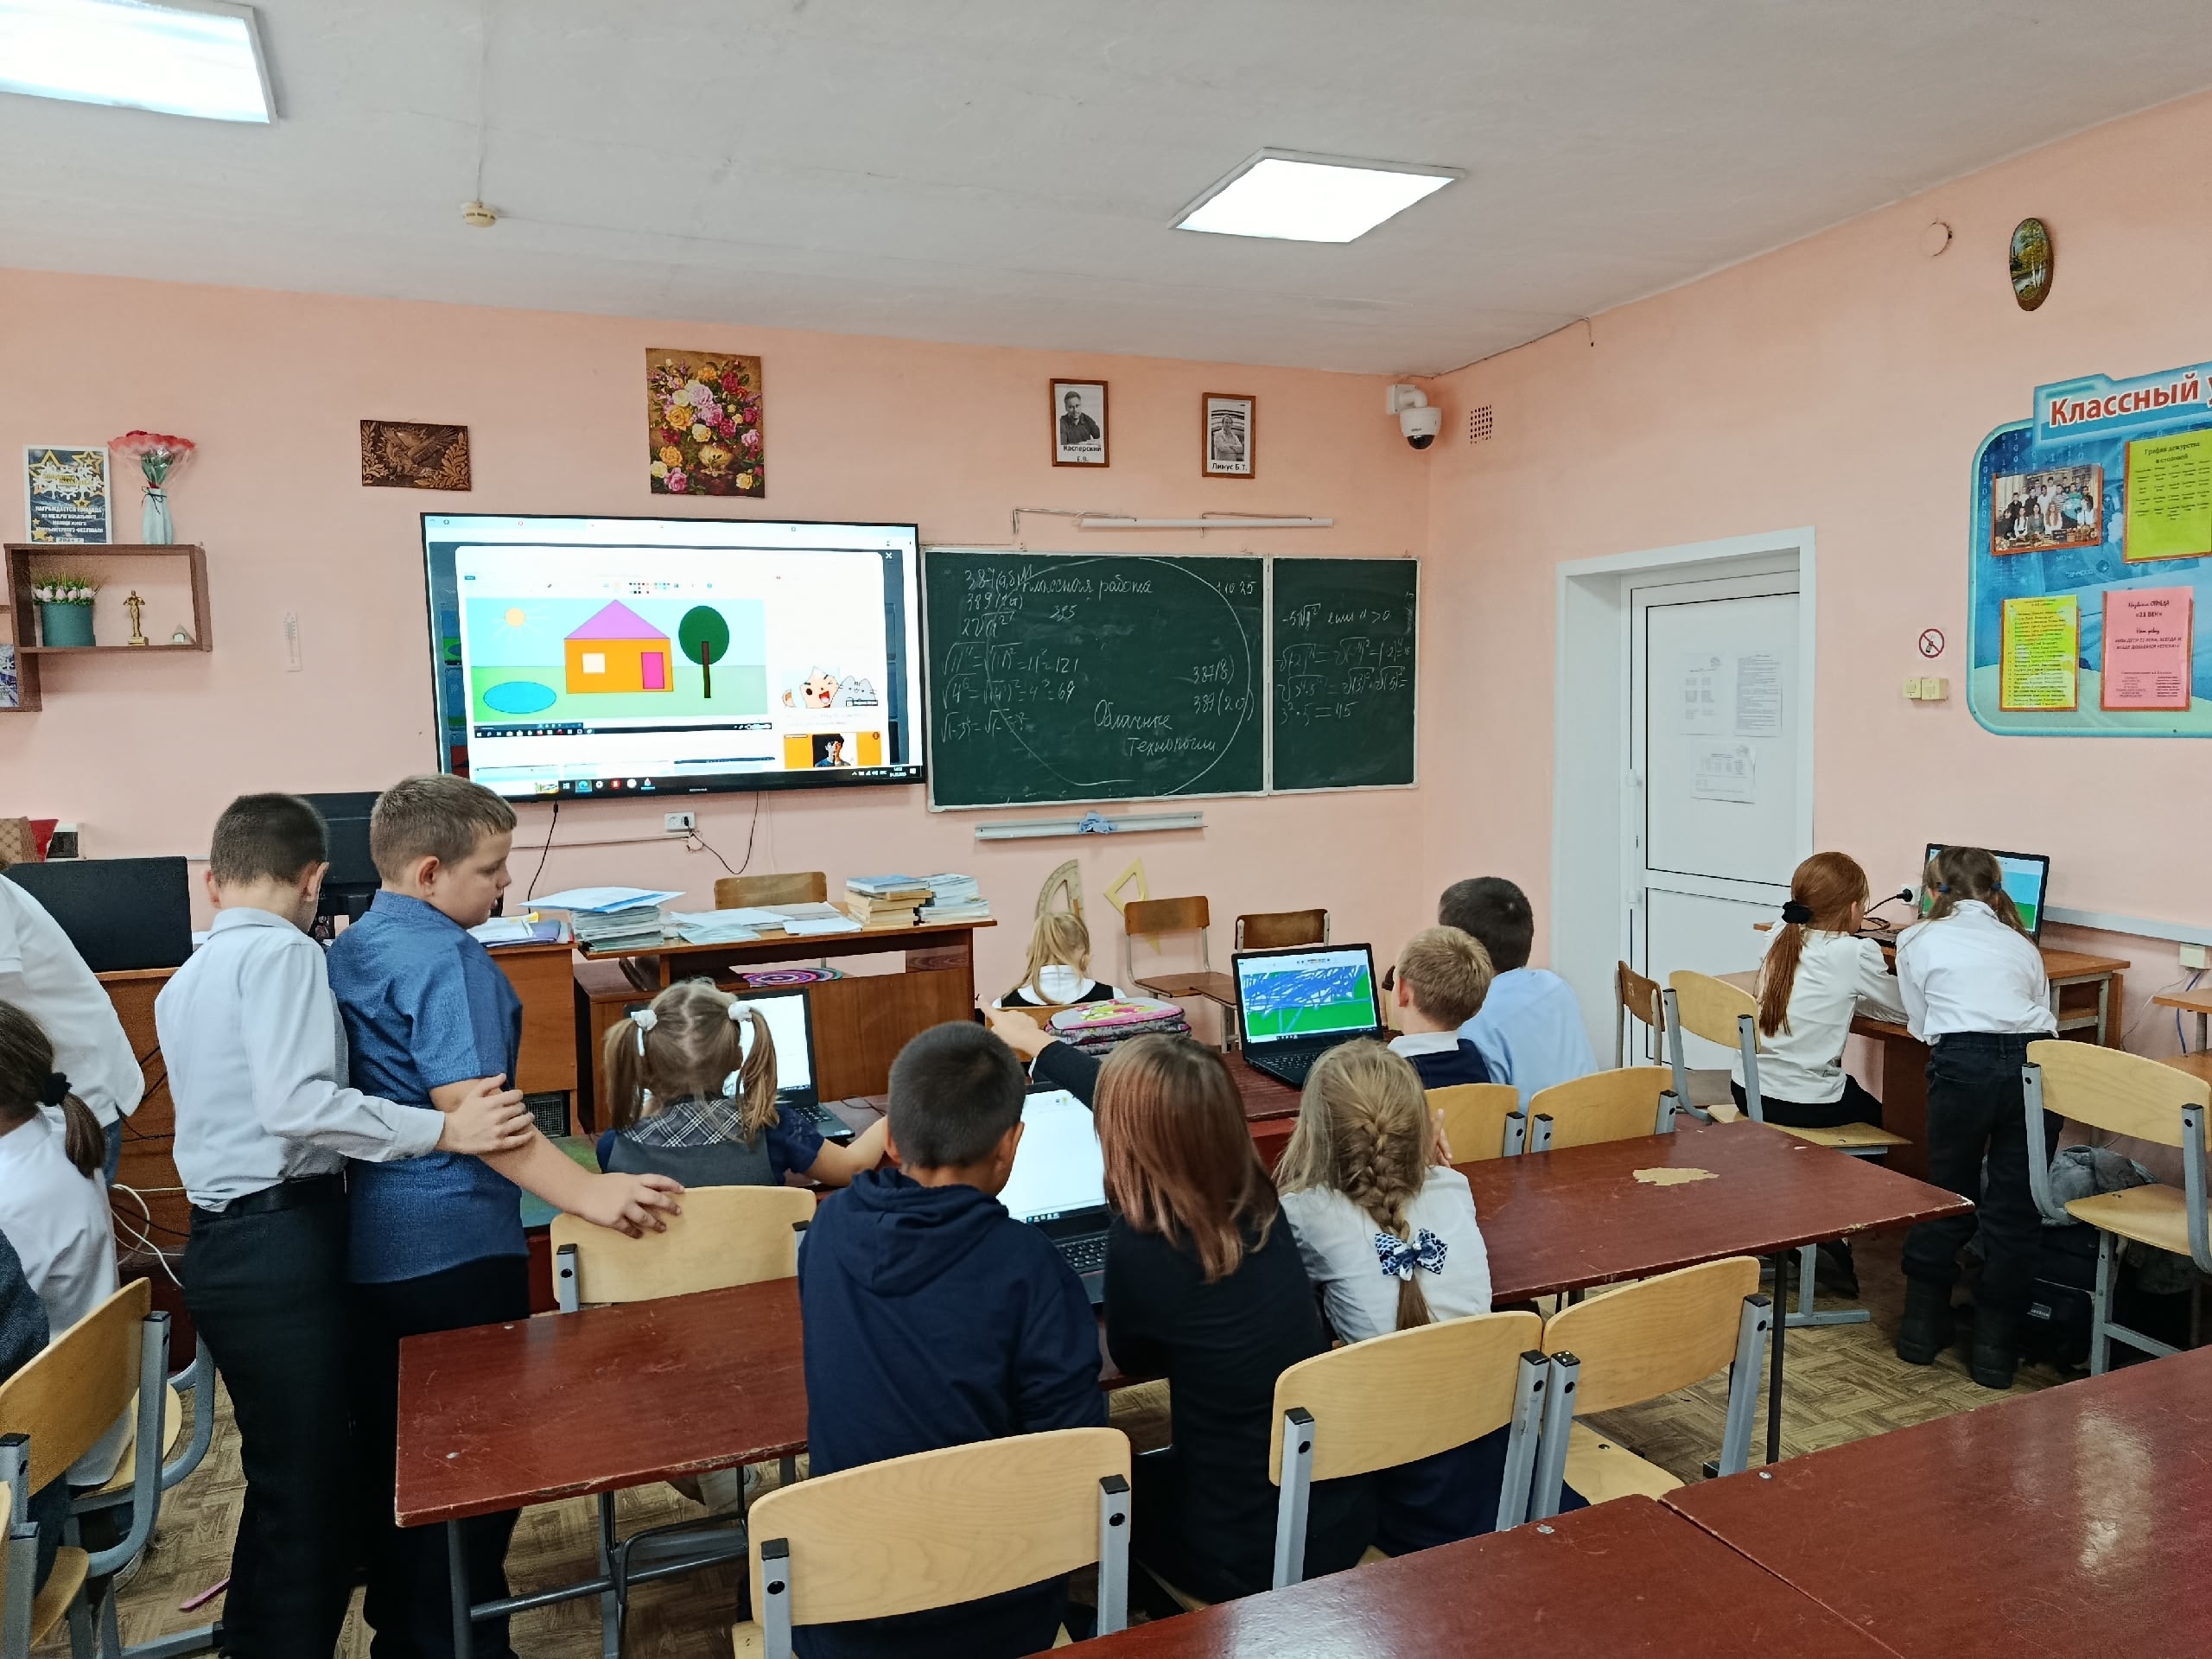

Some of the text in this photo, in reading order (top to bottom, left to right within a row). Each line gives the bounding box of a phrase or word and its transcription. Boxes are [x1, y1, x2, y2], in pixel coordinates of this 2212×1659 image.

[2050, 372, 2199, 426] Классный
[2169, 442, 2200, 452] дежурства
[2160, 454, 2188, 462] столовой
[1212, 463, 1234, 472] Линус
[1098, 575, 1154, 601] работа
[1127, 737, 1217, 757] Технологии
